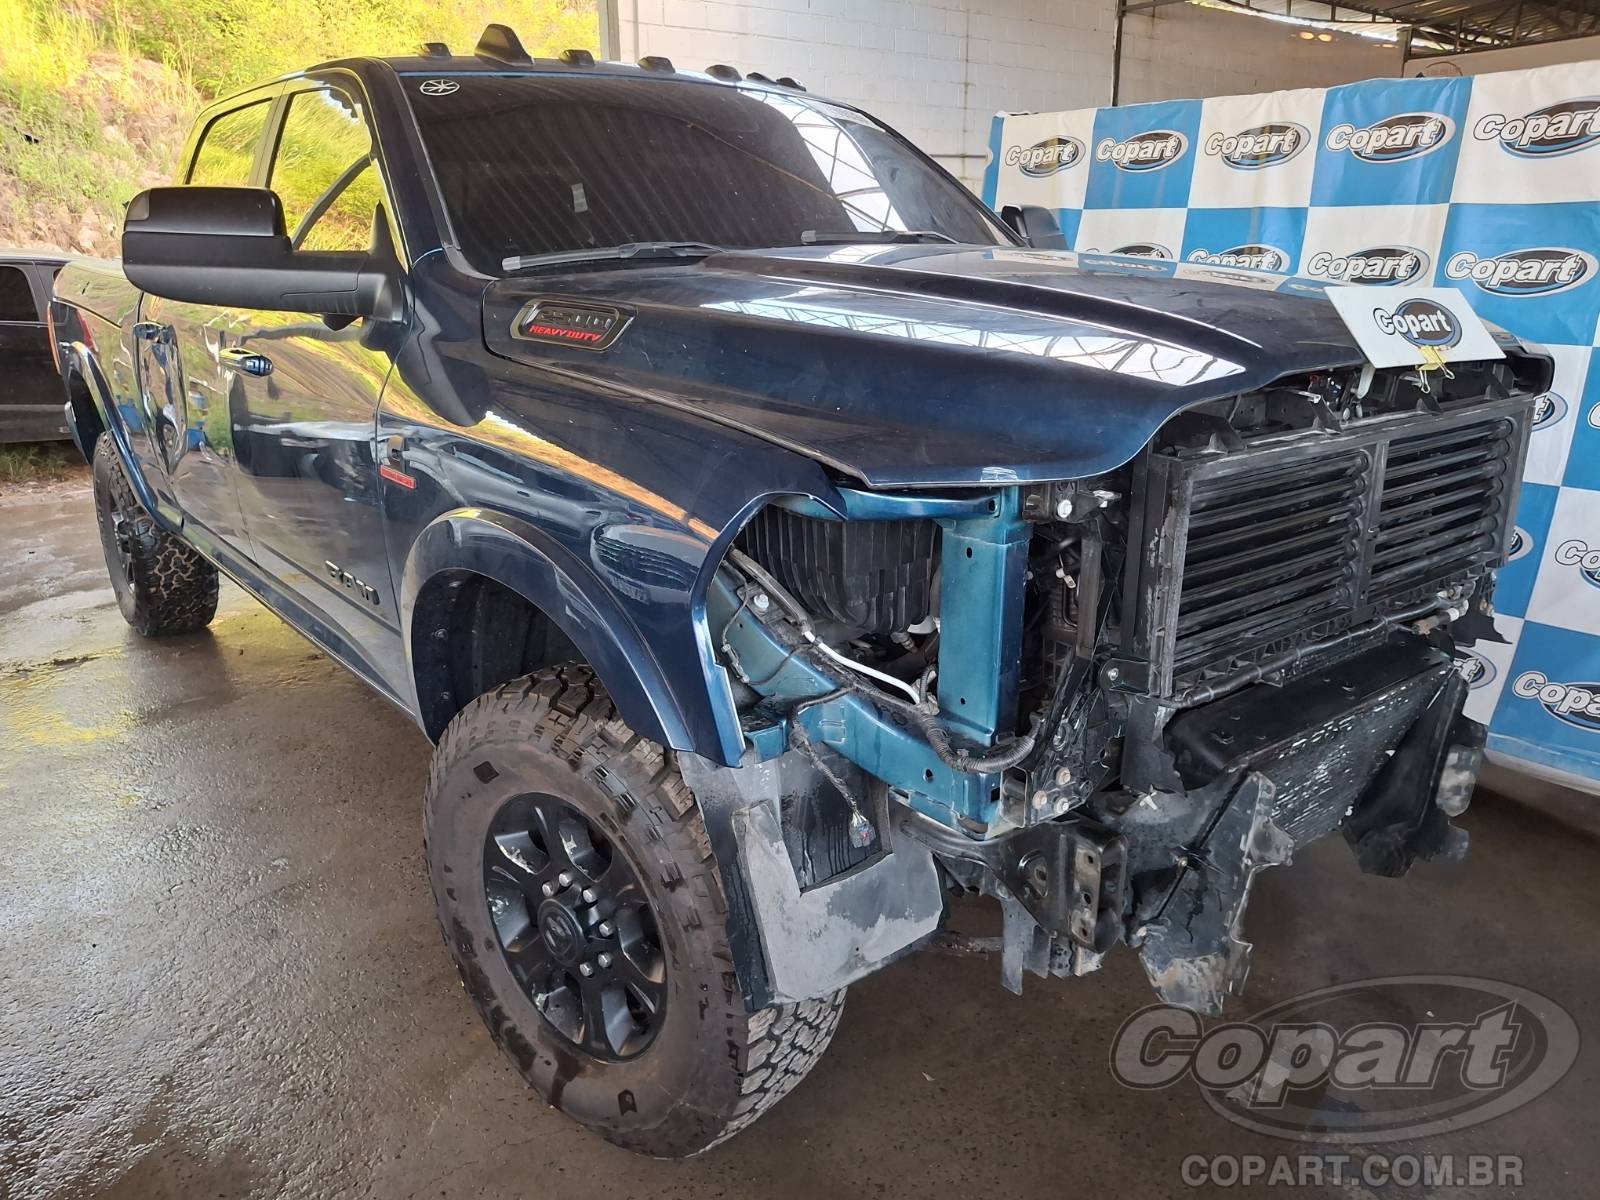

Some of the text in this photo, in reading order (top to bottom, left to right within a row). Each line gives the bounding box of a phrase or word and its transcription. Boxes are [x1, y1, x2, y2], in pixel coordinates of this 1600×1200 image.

[1096, 133, 1182, 166] Copart
[1205, 125, 1300, 162] Copart
[1326, 117, 1442, 156] Copart
[1005, 139, 1077, 168] Copart
[1307, 251, 1416, 281] Copart
[1446, 251, 1586, 287] Copart
[528, 324, 603, 342] HEAVY DUTY
[1373, 306, 1453, 339] Copart
